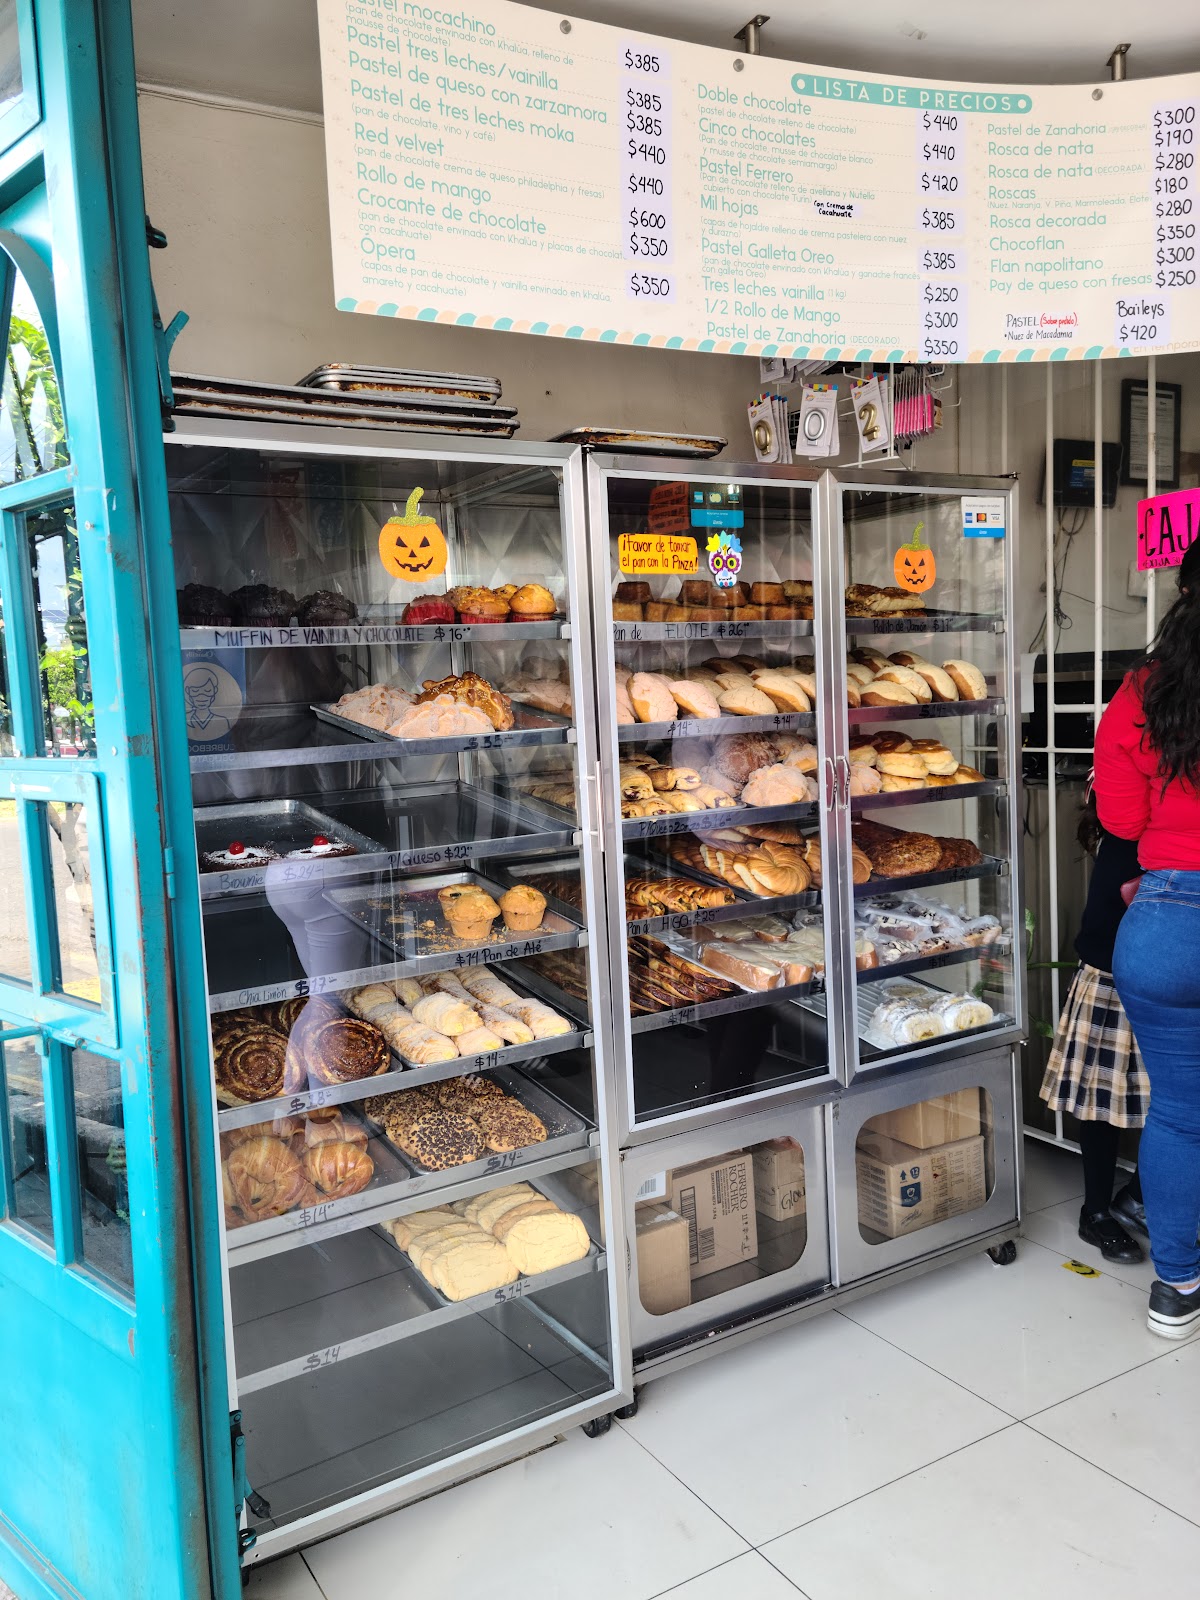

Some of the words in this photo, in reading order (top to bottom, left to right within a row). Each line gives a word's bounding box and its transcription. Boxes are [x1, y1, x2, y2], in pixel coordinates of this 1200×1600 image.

[404, 2, 495, 36] mocachino
[348, 25, 400, 53] Pastel
[407, 39, 438, 62] tres
[625, 49, 660, 72] $385
[350, 50, 401, 78] Pastel
[408, 65, 429, 84] de
[436, 76, 485, 97] queso
[492, 89, 519, 105] con
[525, 95, 607, 123] zarzamora
[812, 78, 870, 101] LISTA
[882, 87, 907, 105] DE
[920, 91, 1012, 111] PRECIOS
[627, 88, 662, 111] $385
[698, 83, 738, 104] Doble
[744, 92, 811, 115] chocolate
[351, 79, 403, 107] Pastel
[410, 93, 431, 112] de
[438, 98, 469, 121] tres
[475, 106, 525, 133] leches
[530, 123, 574, 142] moka
[1153, 107, 1195, 128] $300
[627, 110, 662, 136] $385
[923, 111, 958, 131] $440
[987, 124, 1022, 136] Pastel
[1026, 125, 1041, 136] de
[1046, 124, 1106, 136] Zanahoria
[355, 122, 388, 145] Red
[395, 133, 444, 156] velvet
[699, 118, 736, 136] Cinco
[742, 124, 815, 148] chocolates
[1155, 129, 1193, 147] $190
[628, 138, 665, 164] $440
[923, 143, 955, 161] $440
[988, 142, 1029, 156] Rosca
[1034, 142, 1052, 156] de
[1058, 140, 1094, 155] nata
[700, 157, 742, 176] Pastel
[747, 164, 793, 183] Ferrero
[988, 165, 1028, 178] Rosca
[1034, 164, 1052, 178] de
[1057, 163, 1093, 178] nata
[1155, 152, 1194, 171] $280
[357, 162, 397, 184] Rollo
[404, 171, 425, 190] de
[432, 180, 491, 205] mango
[628, 173, 663, 195] $440
[921, 172, 958, 192] $420
[1155, 177, 1188, 195] $180
[989, 186, 1036, 199] Roscas
[358, 188, 435, 216] Crocante
[442, 202, 463, 220] de
[469, 210, 546, 234] chocolate
[700, 194, 718, 210] Mil
[722, 196, 758, 218] hojas
[1156, 199, 1193, 218] $280
[629, 207, 666, 228] $600
[922, 208, 955, 229] $385
[990, 215, 1031, 228] Rosca
[1036, 211, 1106, 227] decorada
[990, 236, 1064, 251] Chocoflan
[1156, 224, 1196, 243] $350
[360, 233, 415, 261] Ópera
[630, 232, 668, 256] $350
[702, 237, 743, 256] Pastel
[748, 243, 796, 261] Galleta
[801, 248, 834, 264] Oreo
[923, 250, 956, 270] $385
[991, 259, 1020, 273] Flan
[1025, 257, 1104, 276] napolitano
[1156, 247, 1195, 266] $300
[631, 273, 670, 296] $350
[702, 276, 729, 293] Tres
[734, 278, 776, 297] leches
[782, 285, 825, 301] vainilla
[990, 279, 1012, 295] Pay
[1018, 278, 1034, 292] de
[1039, 279, 1078, 294] queso
[1083, 277, 1106, 288] con
[1112, 273, 1153, 287] fresas
[1155, 269, 1196, 288] $250
[924, 284, 958, 304] $250
[705, 298, 729, 315] 1/2
[734, 301, 766, 318] Rollo
[771, 304, 788, 319] de
[794, 306, 841, 327] Mango
[1116, 300, 1164, 319] Baileys
[924, 312, 958, 330] $300
[1006, 314, 1039, 327] PASTEL
[707, 322, 749, 339] Pastel
[754, 325, 771, 340] de
[776, 327, 846, 345] Zanahoria
[1026, 330, 1033, 339] de
[1119, 324, 1157, 342] $420
[924, 337, 958, 356] $350
[656, 536, 665, 552] de
[623, 554, 629, 566] el
[633, 559, 645, 573] pan
[648, 558, 658, 567] con
[662, 554, 668, 567] la
[216, 631, 272, 646] MUFFIN
[279, 629, 299, 645] DE
[354, 628, 363, 644] Y
[631, 624, 642, 640] de
[506, 945, 518, 956] de
